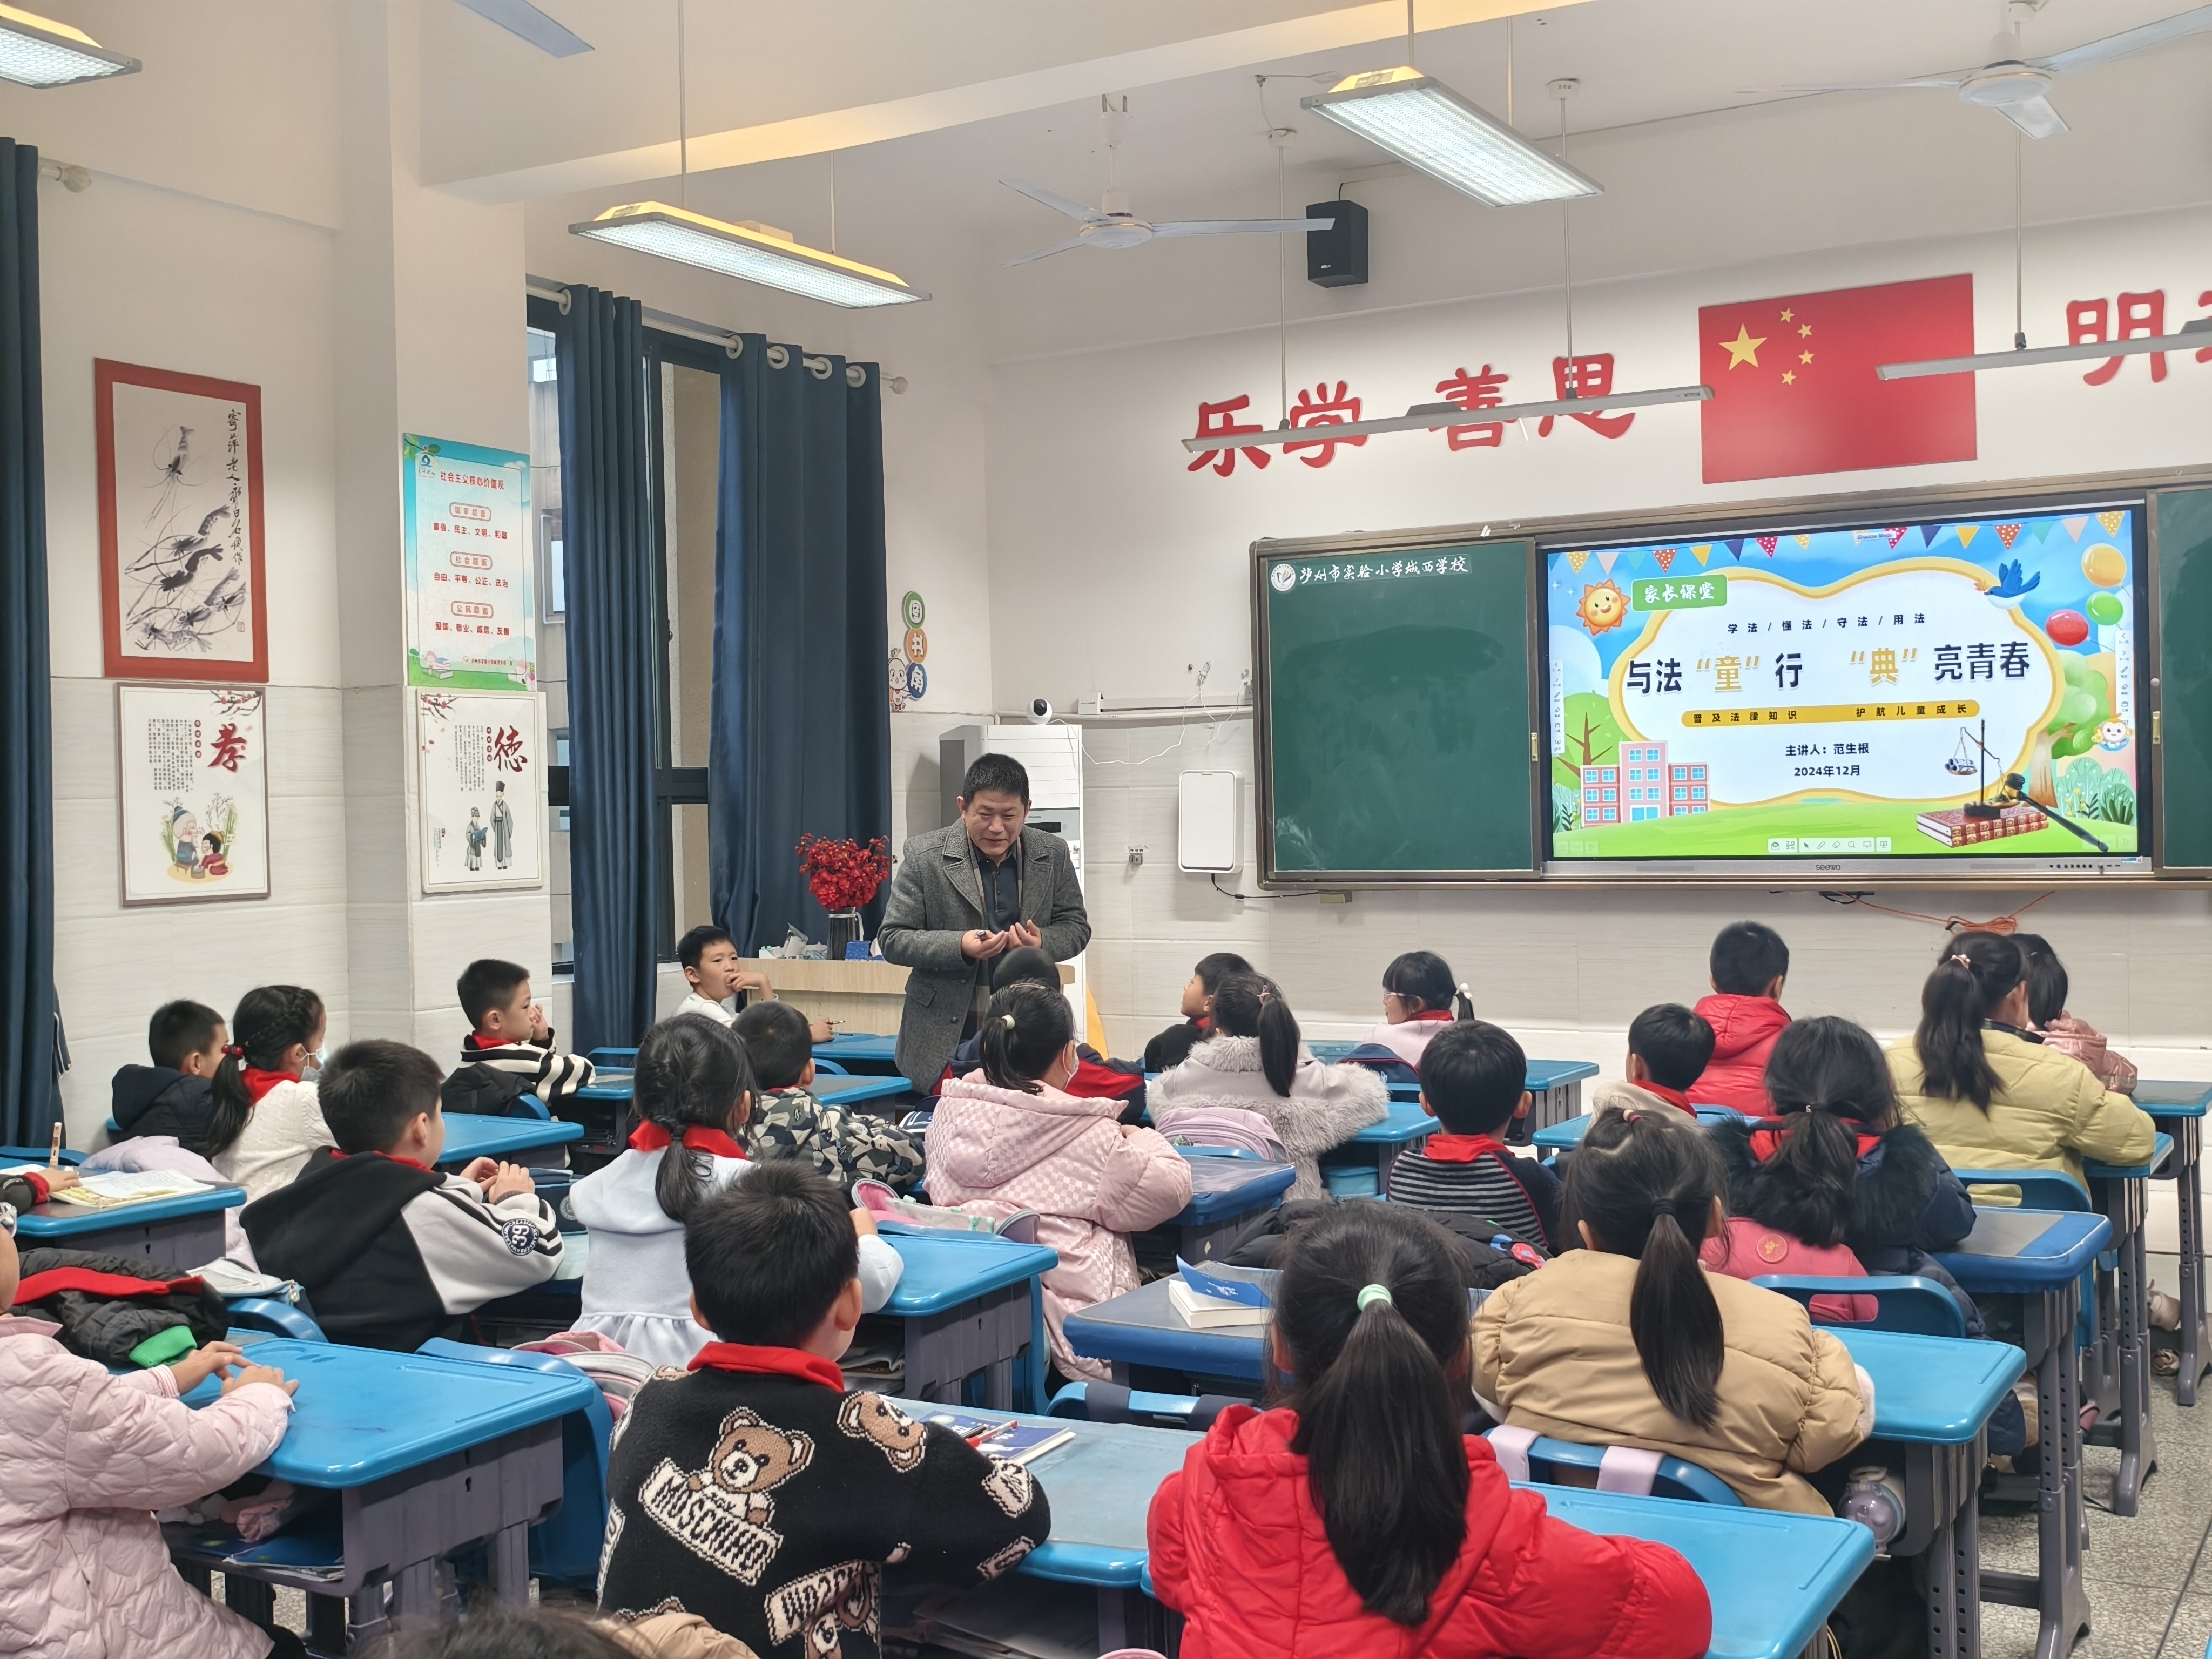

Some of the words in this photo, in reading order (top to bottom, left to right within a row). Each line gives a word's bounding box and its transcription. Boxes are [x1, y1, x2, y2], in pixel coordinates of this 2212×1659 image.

[1187, 380, 1368, 477] 乐学
[1428, 352, 1636, 453] 善思
[2066, 289, 2212, 387] 明
[440, 470, 504, 490] 社会主义核心价值观
[1644, 582, 1716, 603] 家长课堂
[1693, 710, 1797, 724] 普及法律知识
[1856, 704, 1967, 717] 护航儿童成长
[207, 723, 247, 772] 孝
[494, 725, 528, 772] 德
[1785, 743, 1870, 756] 主讲人：范生根
[1794, 765, 1860, 777] 2024年12月
